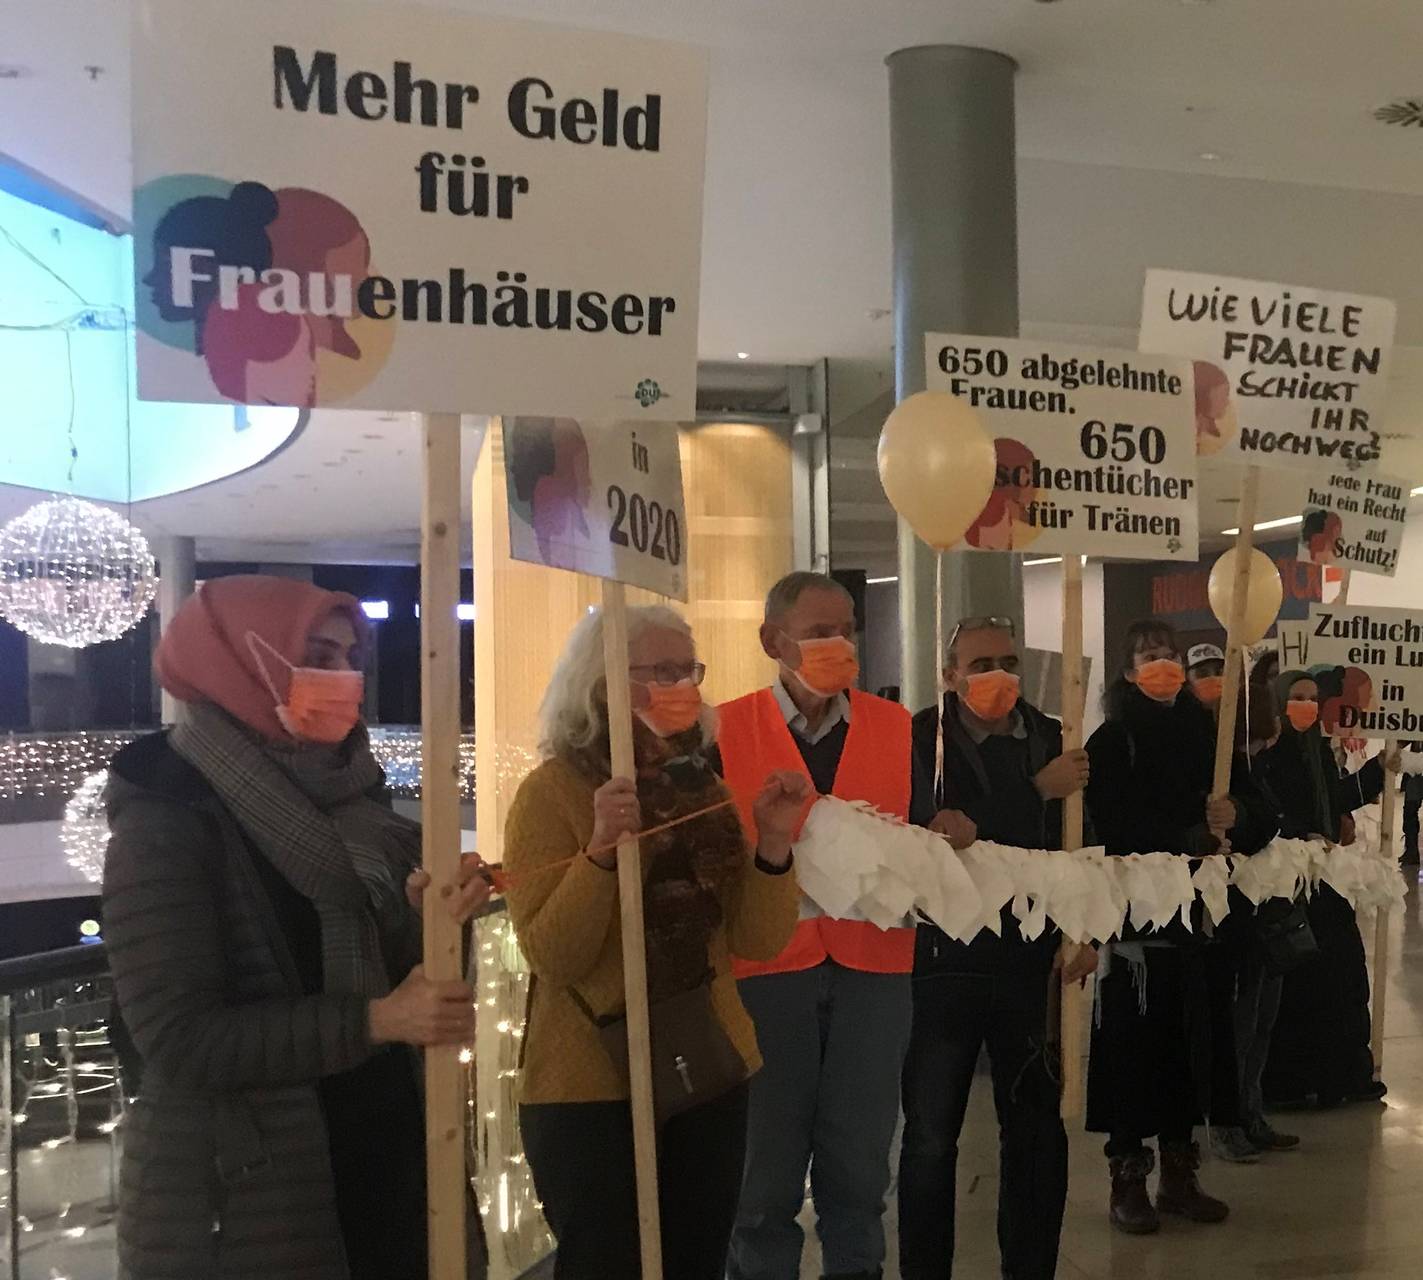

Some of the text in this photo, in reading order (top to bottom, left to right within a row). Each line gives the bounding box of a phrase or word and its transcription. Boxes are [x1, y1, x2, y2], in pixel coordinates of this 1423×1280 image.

[273, 46, 661, 151] Mehr Geld
[416, 152, 529, 219] für
[170, 247, 675, 335] Frauenhäuser
[939, 346, 1182, 395] 650 abgelehnte
[1223, 331, 1380, 374] FRAUEN
[1310, 407, 1369, 431] IHR
[631, 431, 649, 474] in
[1080, 421, 1166, 465] 650
[1308, 488, 1406, 523] hat ein Recht
[1366, 479, 1402, 500] Frau
[607, 485, 680, 566] 2020
[1026, 502, 1181, 537] für Tränen
[1365, 528, 1388, 543] auf
[1333, 537, 1398, 568] Schutz!
[1348, 643, 1386, 665] ein
[1382, 679, 1405, 701] in
